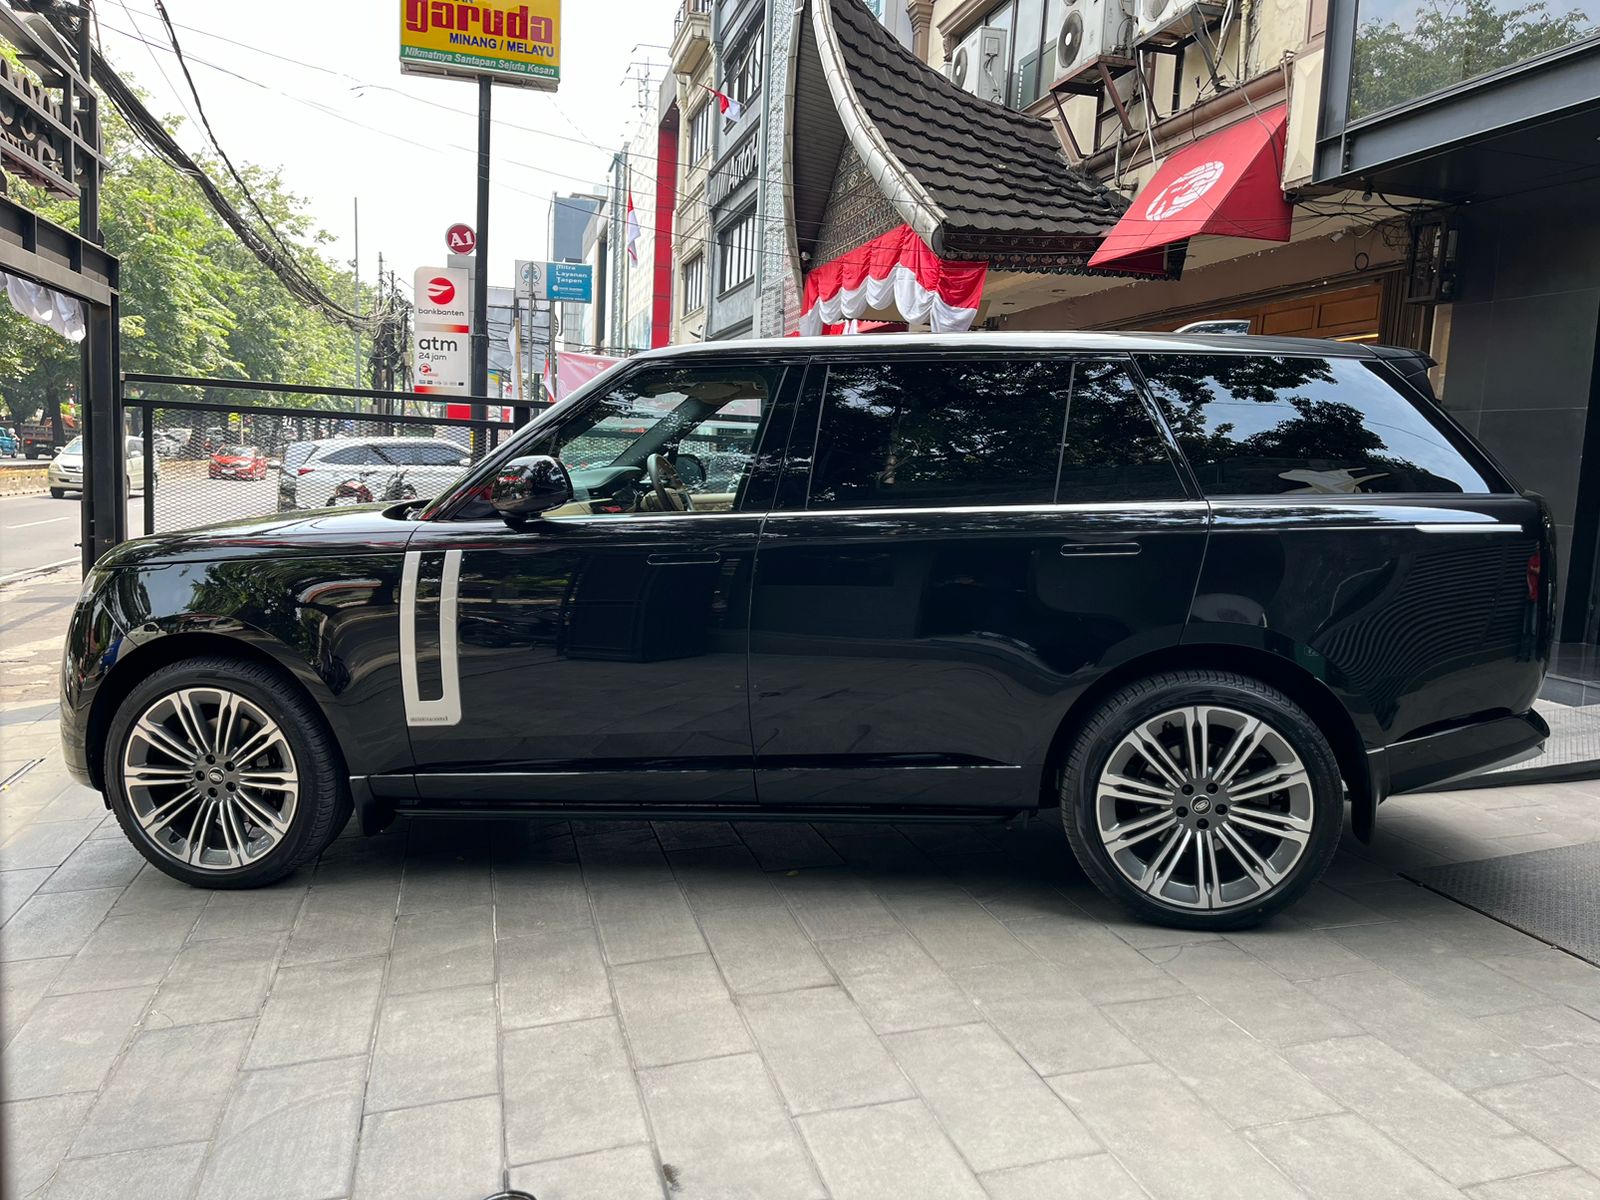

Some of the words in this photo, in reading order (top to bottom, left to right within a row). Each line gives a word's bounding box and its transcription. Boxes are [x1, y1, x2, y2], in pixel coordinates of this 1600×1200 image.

[406, 0, 553, 44] garuda
[449, 33, 497, 49] MINANG
[507, 41, 554, 57] MELAYU
[405, 46, 453, 62] Nikmatnya
[455, 53, 496, 69] Santapan
[498, 59, 526, 71] Sejuta
[527, 63, 555, 75] Kesan
[450, 230, 474, 247] A1
[418, 308, 465, 316] bankbanten
[418, 336, 458, 352] atm
[418, 352, 430, 360] 24
[431, 352, 447, 362] jam
